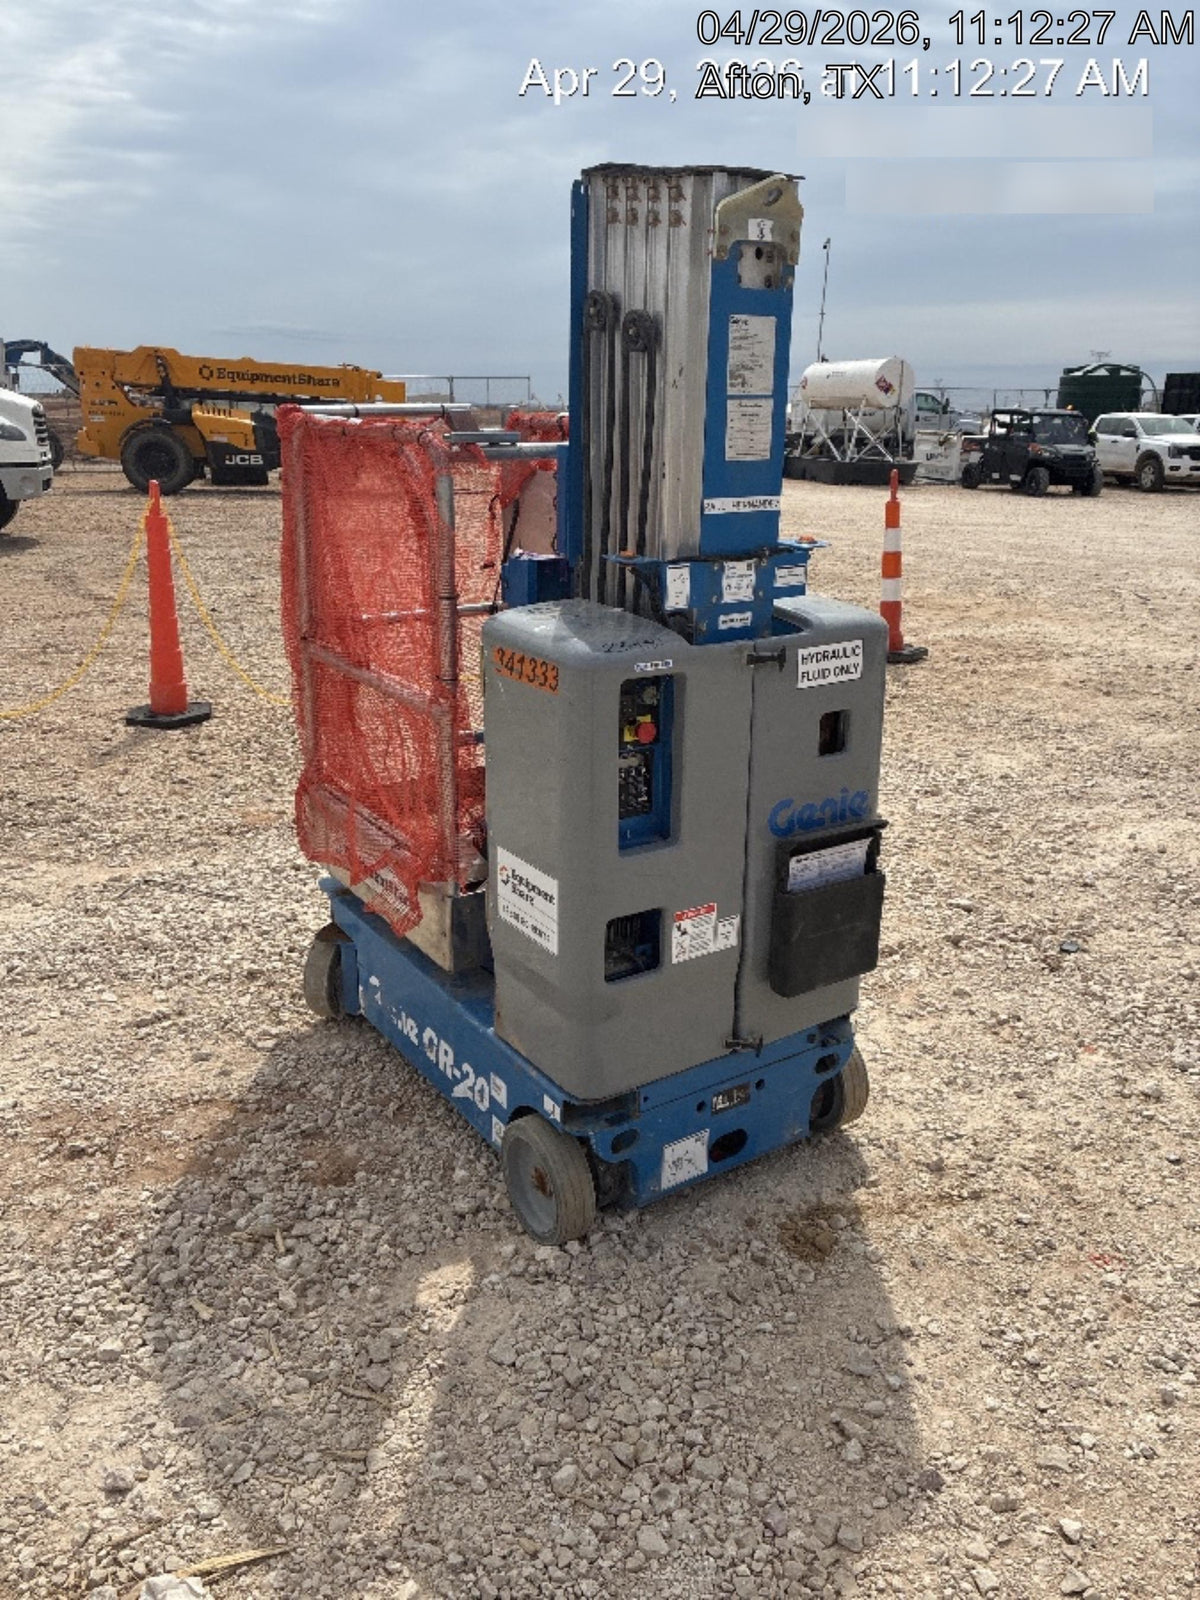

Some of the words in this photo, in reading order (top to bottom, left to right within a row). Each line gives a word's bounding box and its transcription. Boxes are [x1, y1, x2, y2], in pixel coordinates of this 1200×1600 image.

[216, 367, 341, 387] EquipmentShare
[225, 454, 263, 465] JCB
[801, 644, 861, 665] HYDRAULIC
[495, 646, 559, 693] 341333
[801, 667, 831, 682] FLUID
[833, 662, 860, 678] ONLY
[768, 787, 870, 838] Genie
[422, 1026, 490, 1112] GR-20
